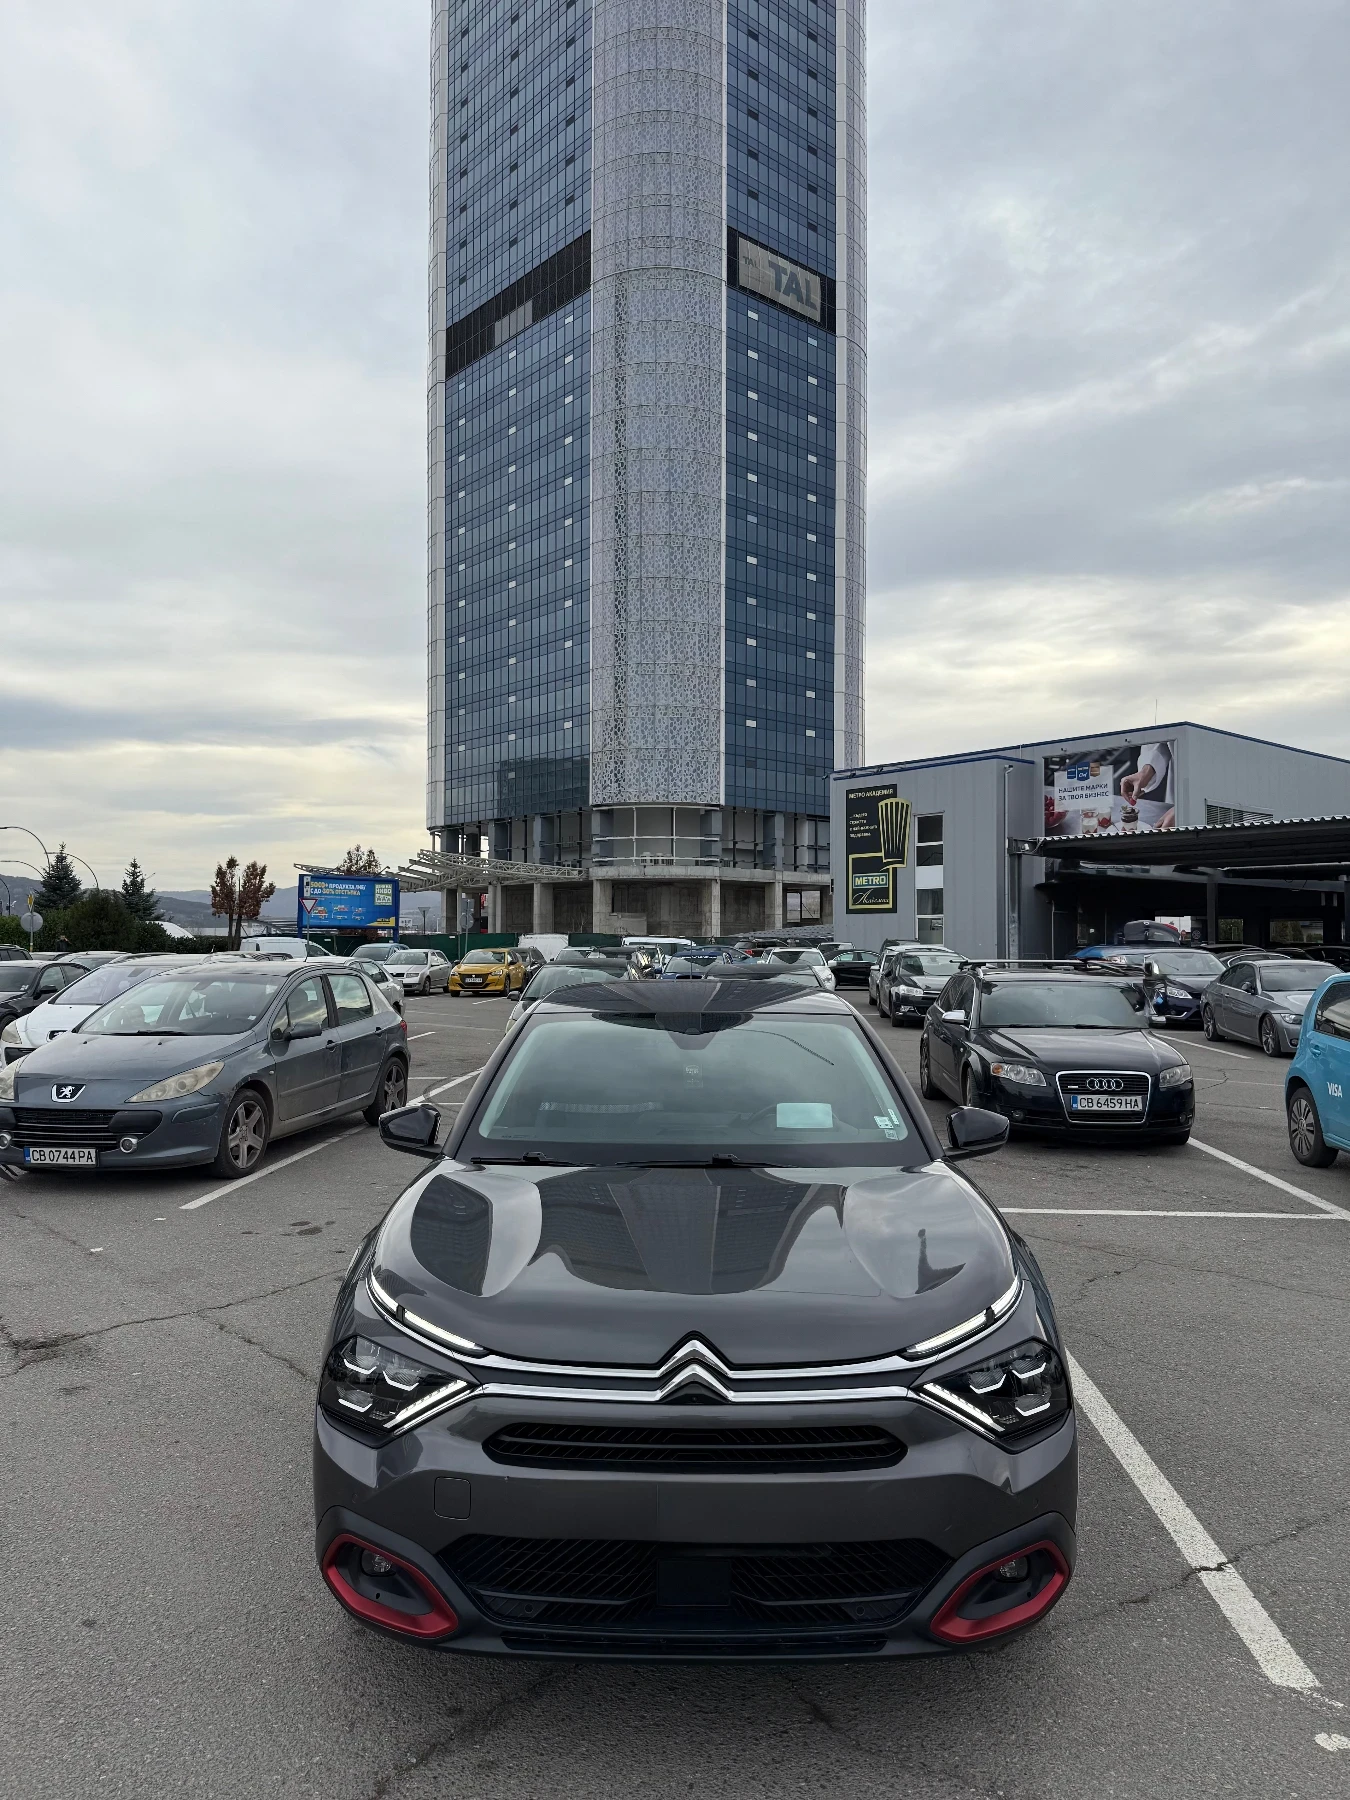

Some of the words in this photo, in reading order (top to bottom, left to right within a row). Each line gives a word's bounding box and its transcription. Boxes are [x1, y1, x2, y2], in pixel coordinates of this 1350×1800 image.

[768, 260, 818, 311] TAL
[848, 791, 866, 799] МЕТРО
[865, 788, 894, 797] АКАДЕМИЯ
[1058, 785, 1085, 794] НАШИТЕ
[1085, 783, 1108, 791] МАРКИ
[1084, 790, 1109, 799] БИЗНЕС
[855, 875, 886, 886] METRO
[1326, 1081, 1343, 1098] VISA
[1096, 1097, 1123, 1109] 6459
[48, 1149, 76, 1163] 0744
